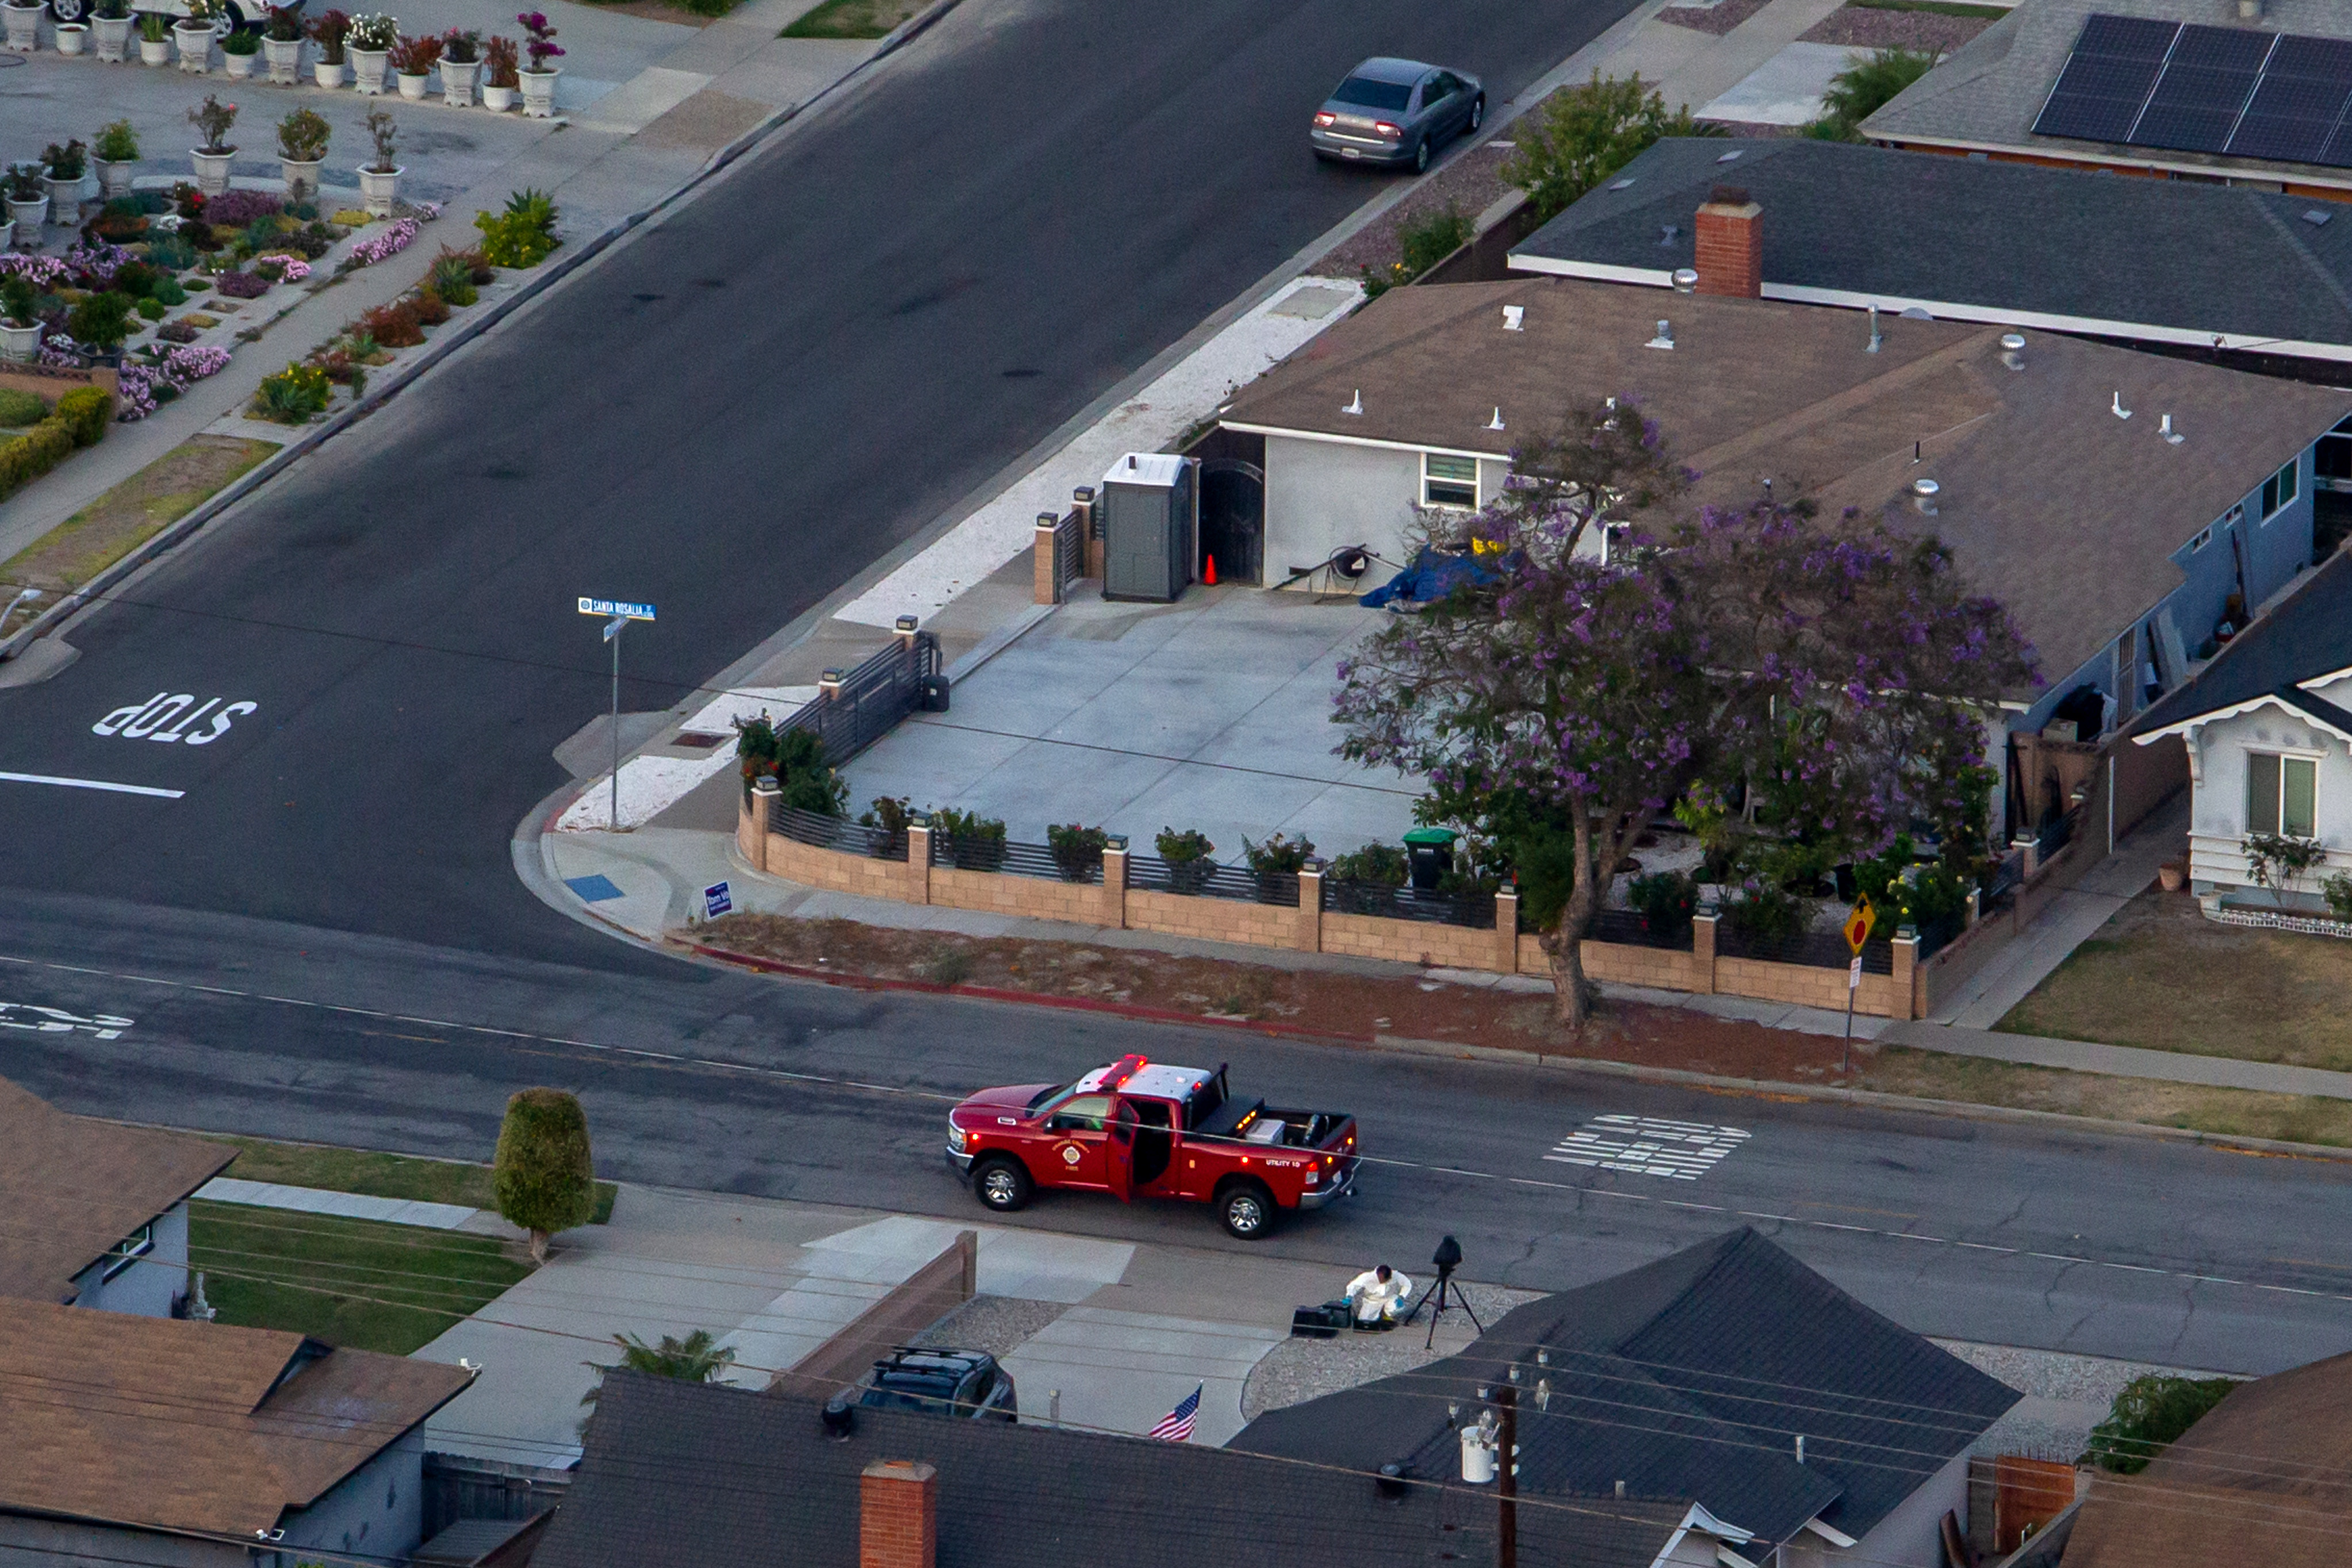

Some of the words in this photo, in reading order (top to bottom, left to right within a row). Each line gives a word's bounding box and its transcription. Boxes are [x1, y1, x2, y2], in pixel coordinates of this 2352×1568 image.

[593, 600, 614, 612] SANTA
[615, 603, 643, 615] ROSALIA
[92, 692, 258, 745] STOP
[707, 895, 721, 905] Tom
[1542, 1114, 1752, 1180] AHEAD
[1266, 1159, 1289, 1167] UTILITY
